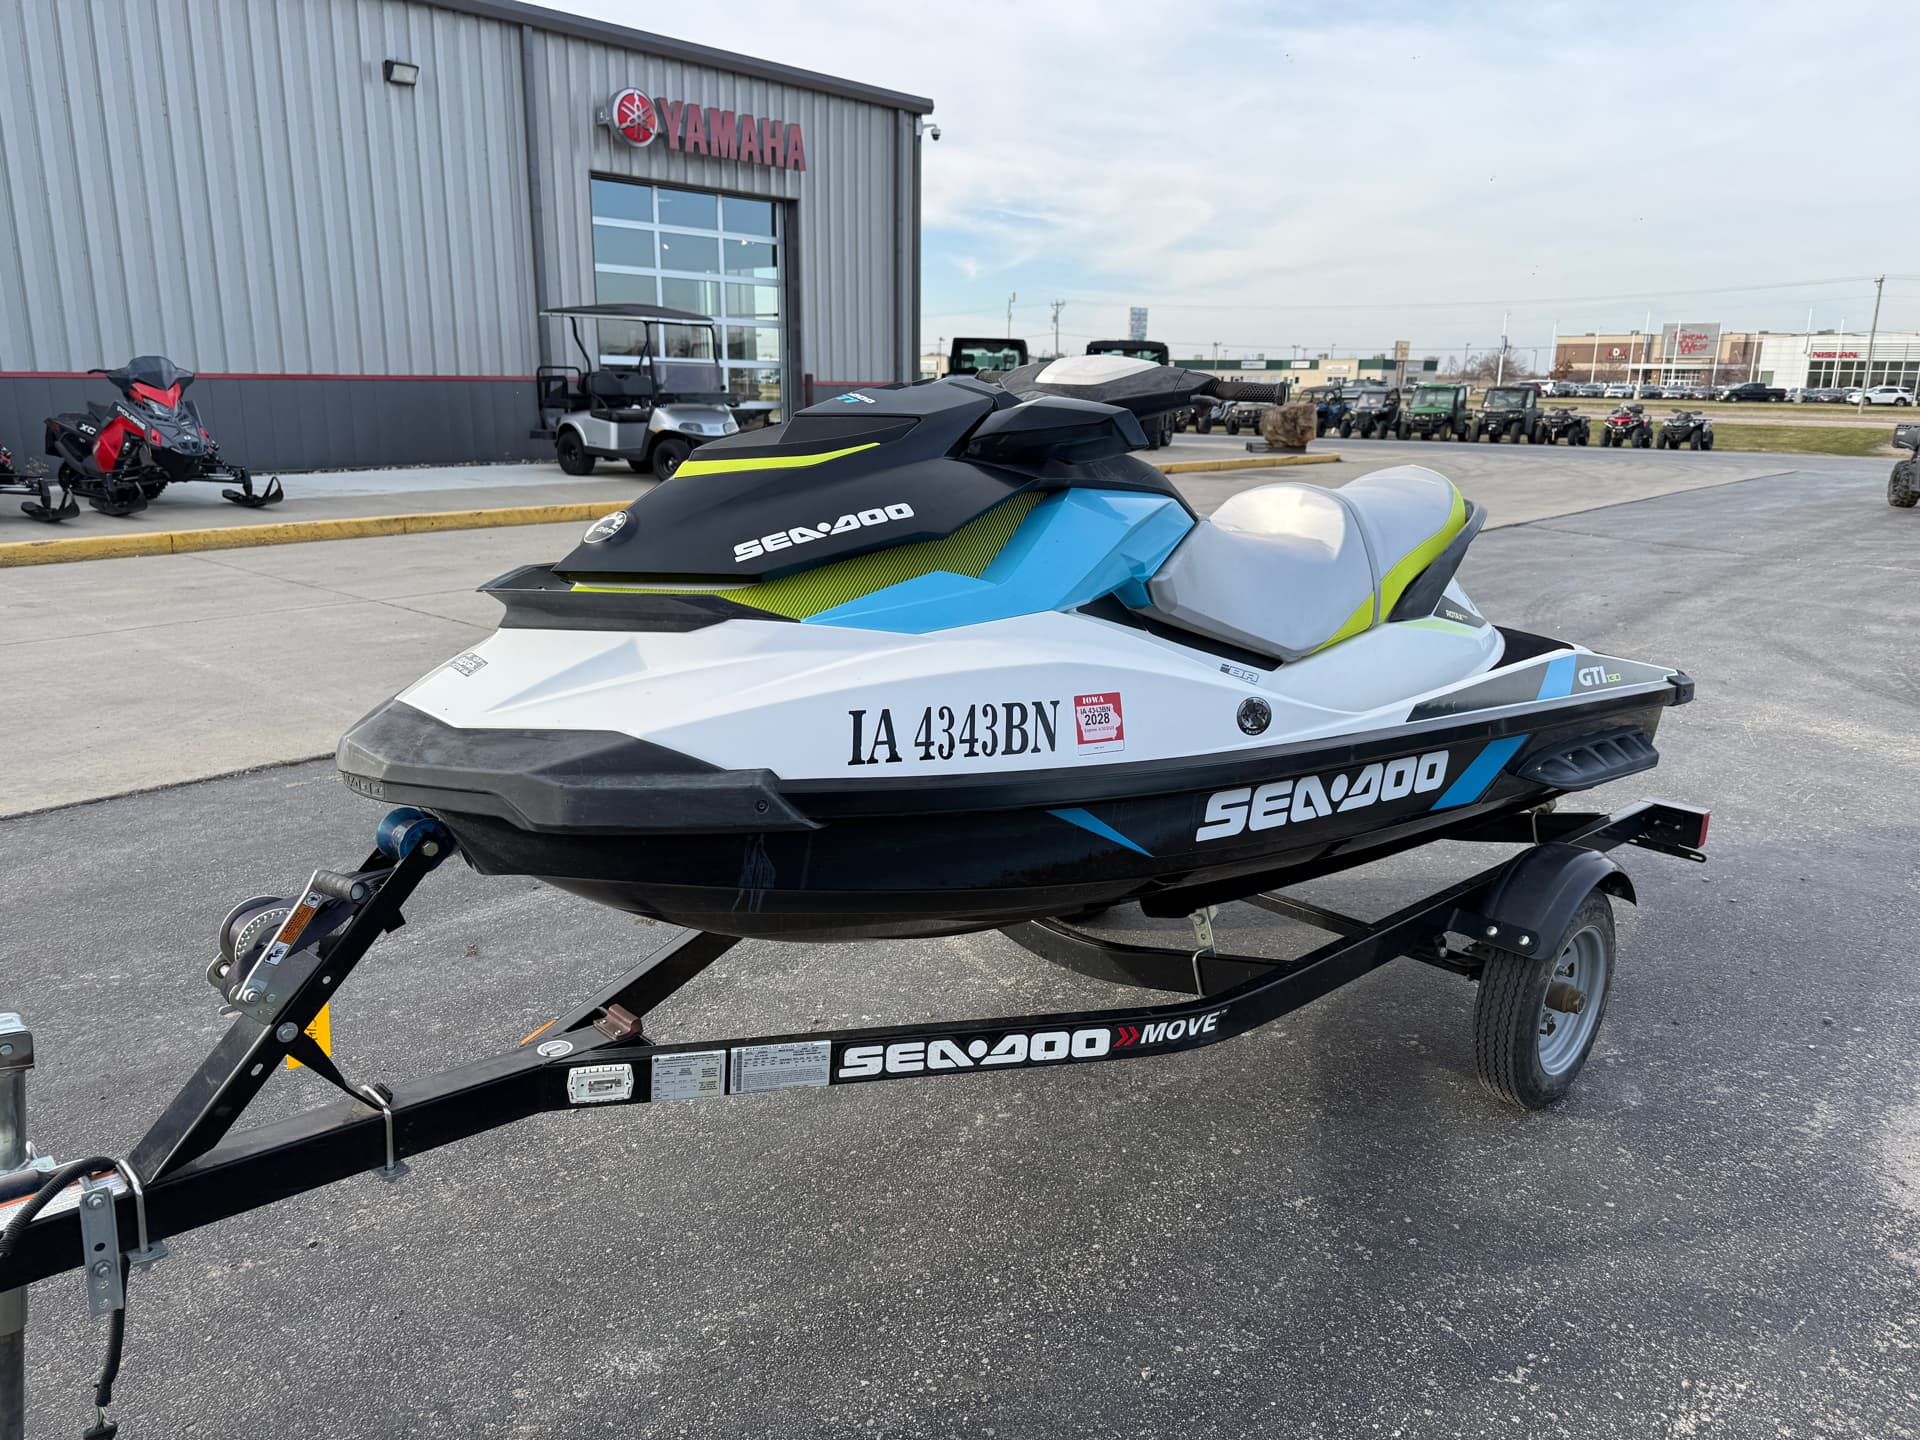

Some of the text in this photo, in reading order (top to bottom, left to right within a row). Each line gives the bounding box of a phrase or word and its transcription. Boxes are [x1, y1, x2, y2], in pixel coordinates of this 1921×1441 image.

[655, 97, 807, 171] YAMAHA
[1812, 351, 1857, 359] NISSAN
[1578, 665, 1607, 687] GTI
[1082, 695, 1105, 705] IOWA
[1084, 712, 1110, 726] 2028
[847, 700, 1060, 766] IA 4343BN
